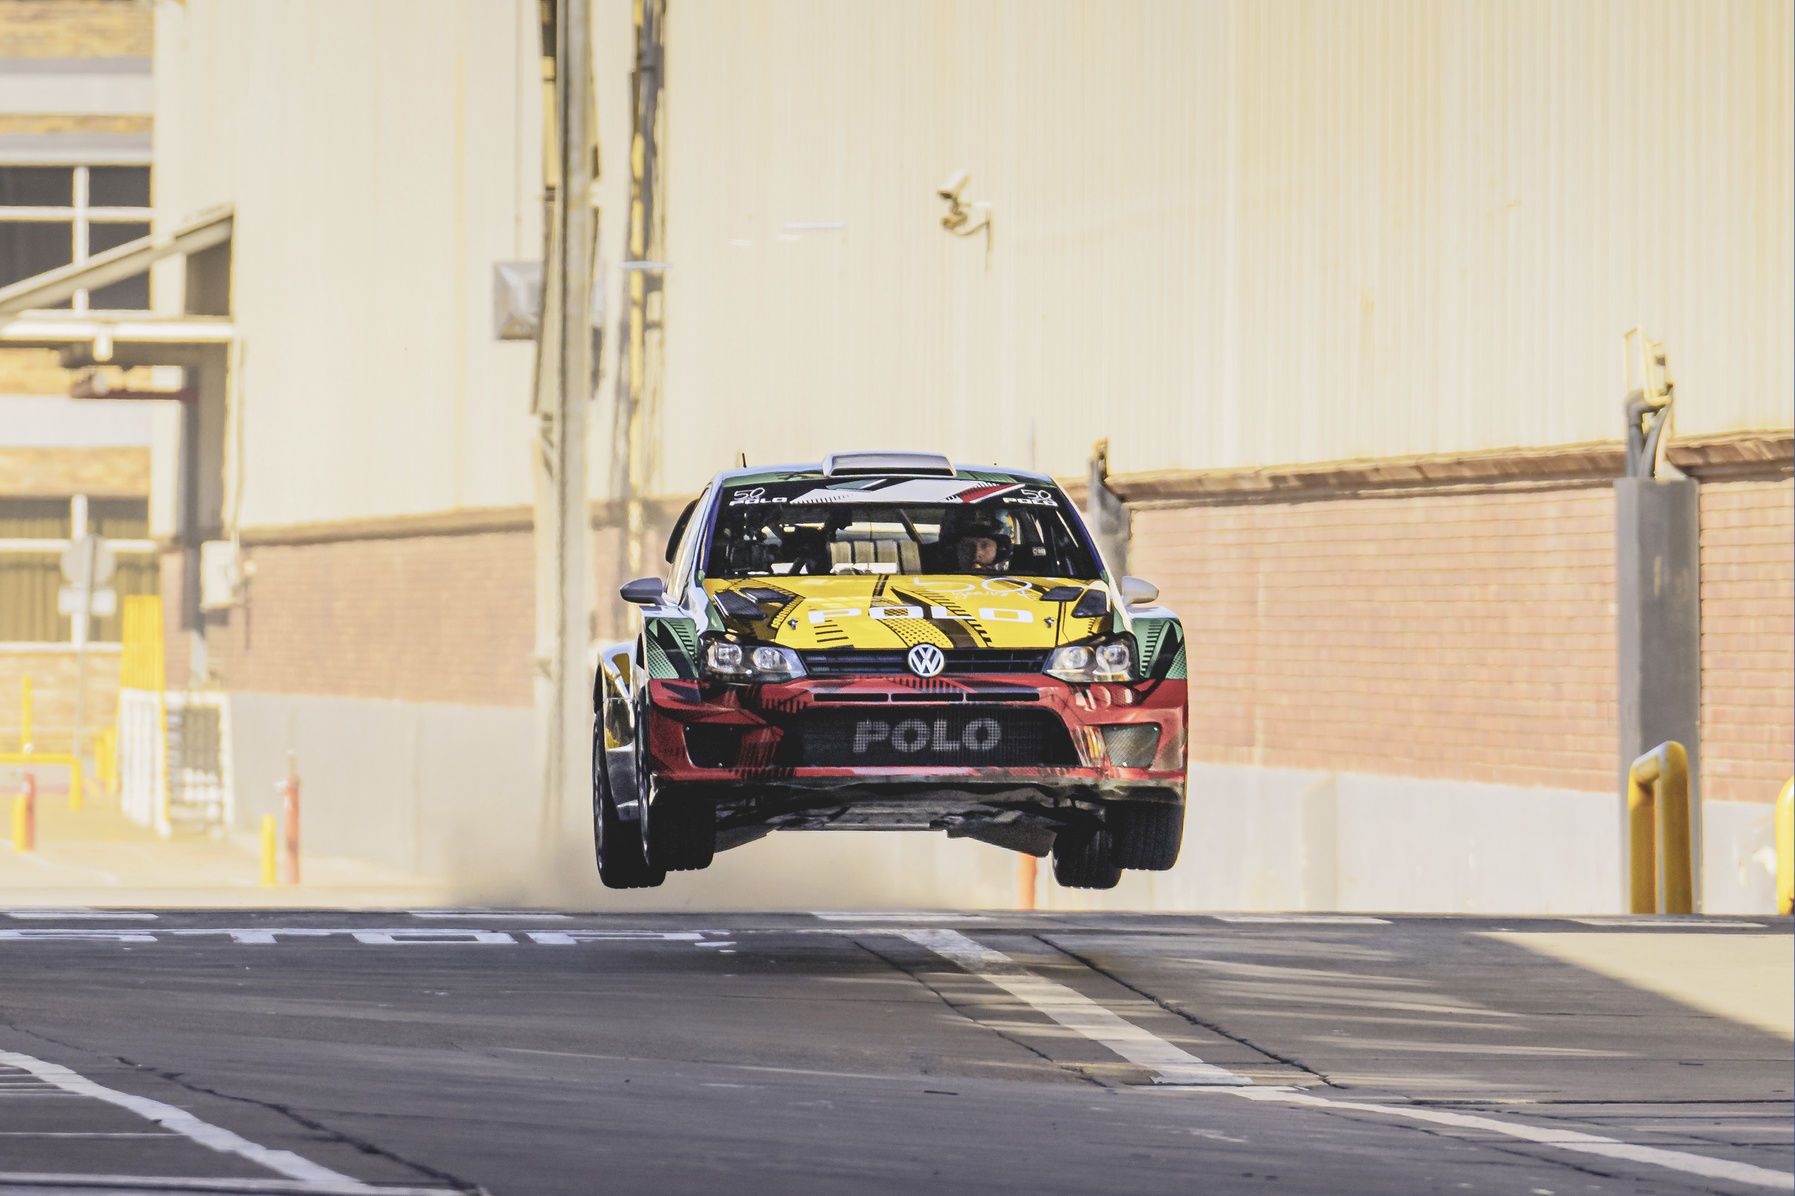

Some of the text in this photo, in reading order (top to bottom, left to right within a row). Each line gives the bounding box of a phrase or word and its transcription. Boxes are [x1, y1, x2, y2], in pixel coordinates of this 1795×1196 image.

[729, 497, 788, 506] POLO
[733, 487, 765, 500] 50
[1020, 488, 1052, 500] 50
[808, 605, 1034, 624] POLO
[908, 644, 944, 677] VW
[852, 717, 1002, 753] POLO
